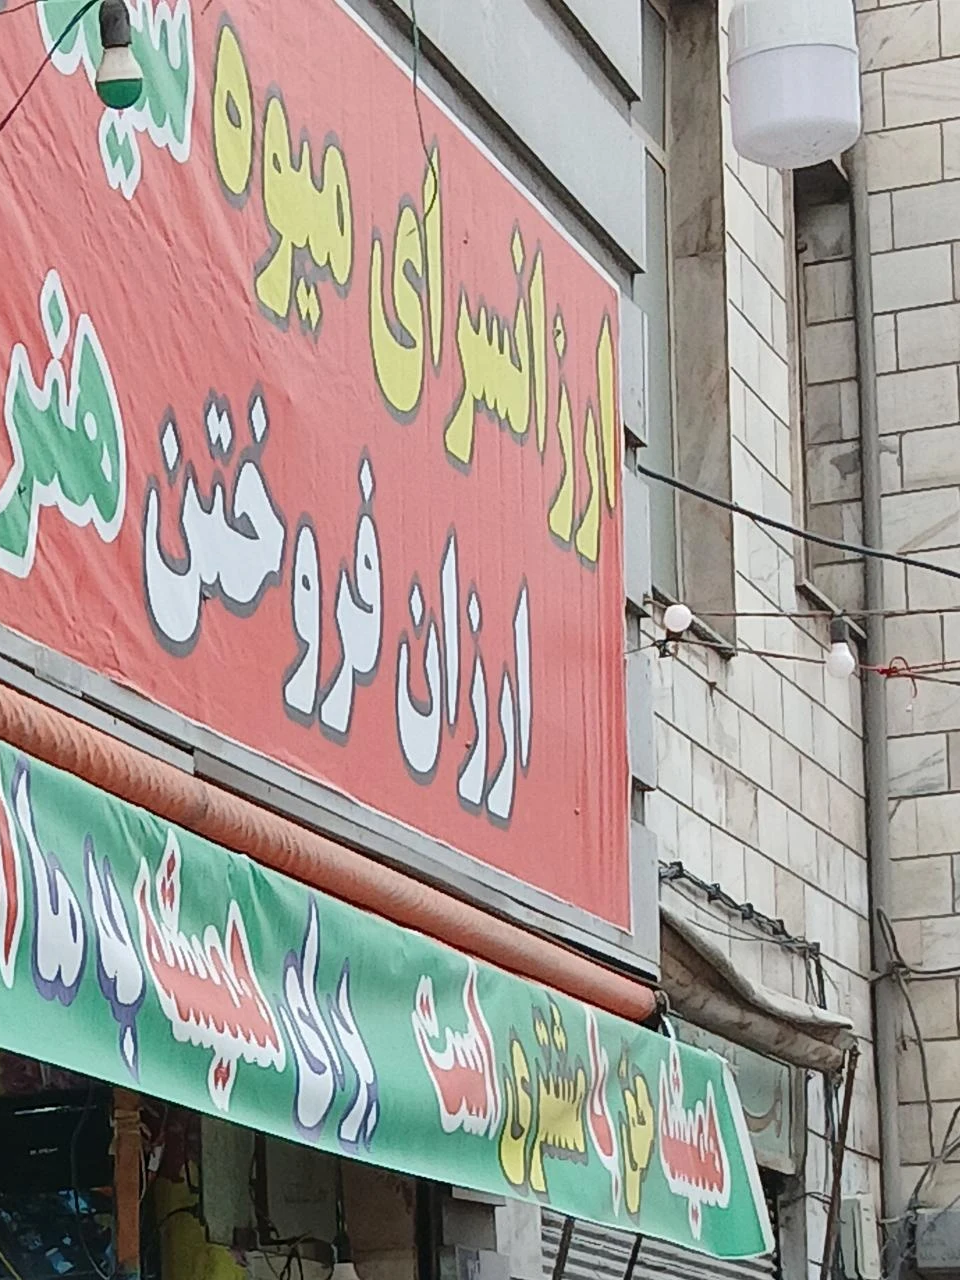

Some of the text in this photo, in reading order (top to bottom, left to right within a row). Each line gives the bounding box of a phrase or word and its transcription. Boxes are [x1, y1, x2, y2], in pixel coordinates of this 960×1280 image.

[212, 22, 353, 332] میوه
[142, 388, 384, 743] فروختن
[396, 528, 532, 823] ارزان
[12, 756, 88, 1007] ما
[82, 832, 146, 1083] به
[134, 828, 286, 1112] همیشه
[274, 893, 381, 1152] برای
[411, 958, 502, 1141] است
[498, 995, 589, 1202] مشتری
